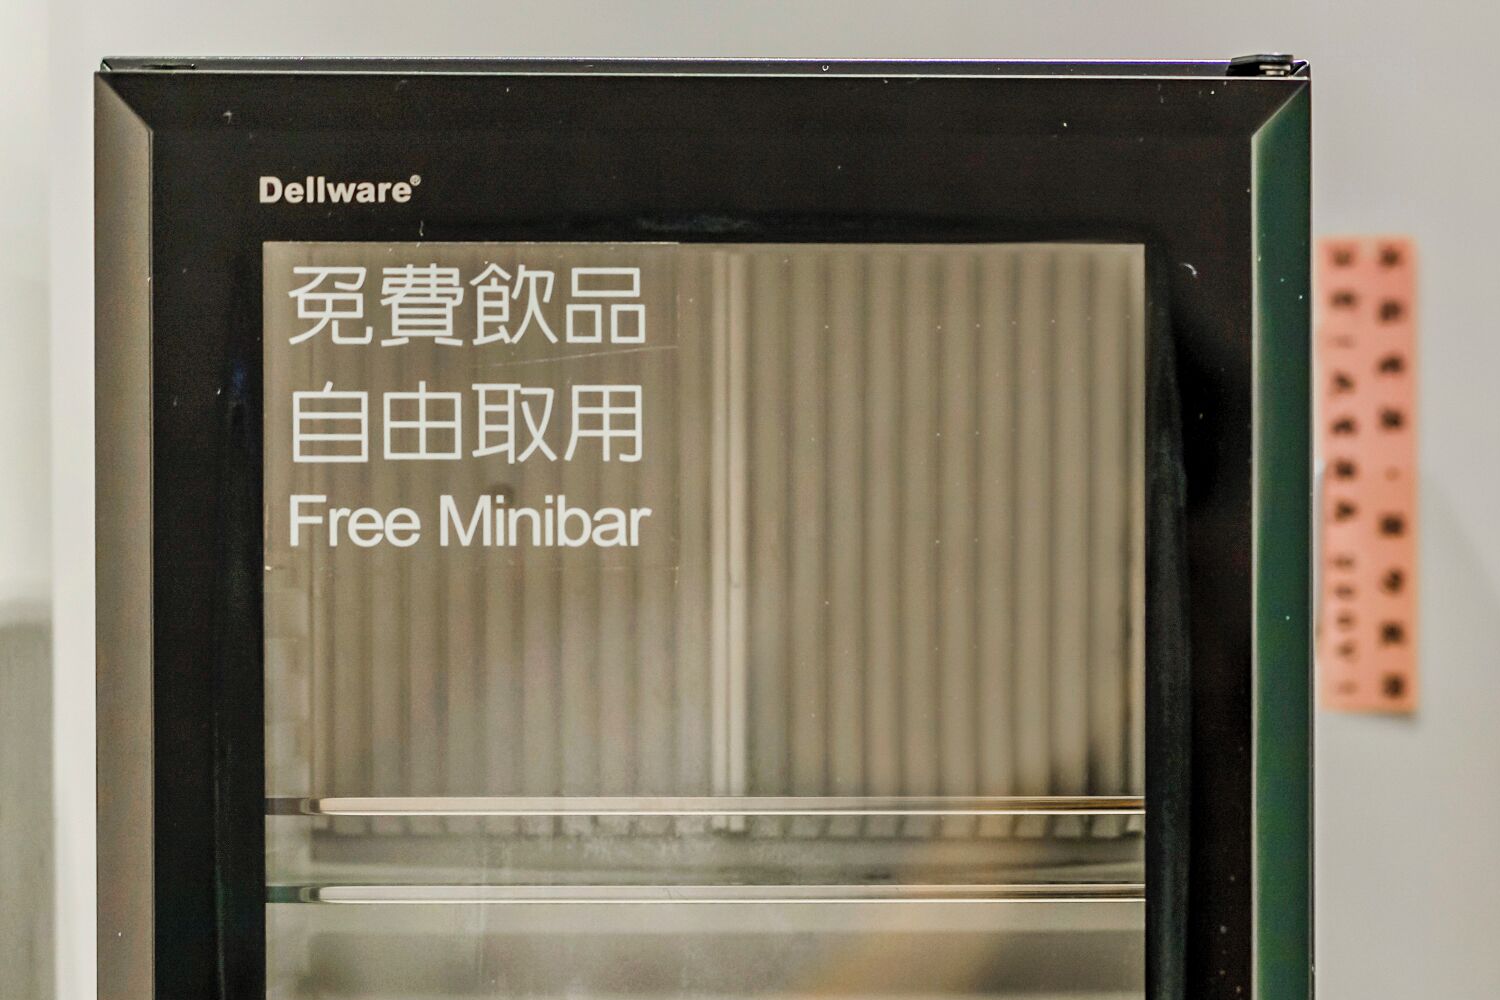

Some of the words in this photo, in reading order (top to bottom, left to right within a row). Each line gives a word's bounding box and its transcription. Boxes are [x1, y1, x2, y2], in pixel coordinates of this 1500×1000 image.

[260, 176, 413, 204] Dellware
[289, 263, 646, 347] 免費飲品
[291, 381, 643, 465] 自由取用
[290, 495, 421, 548] Free
[440, 494, 652, 548] Minibar
